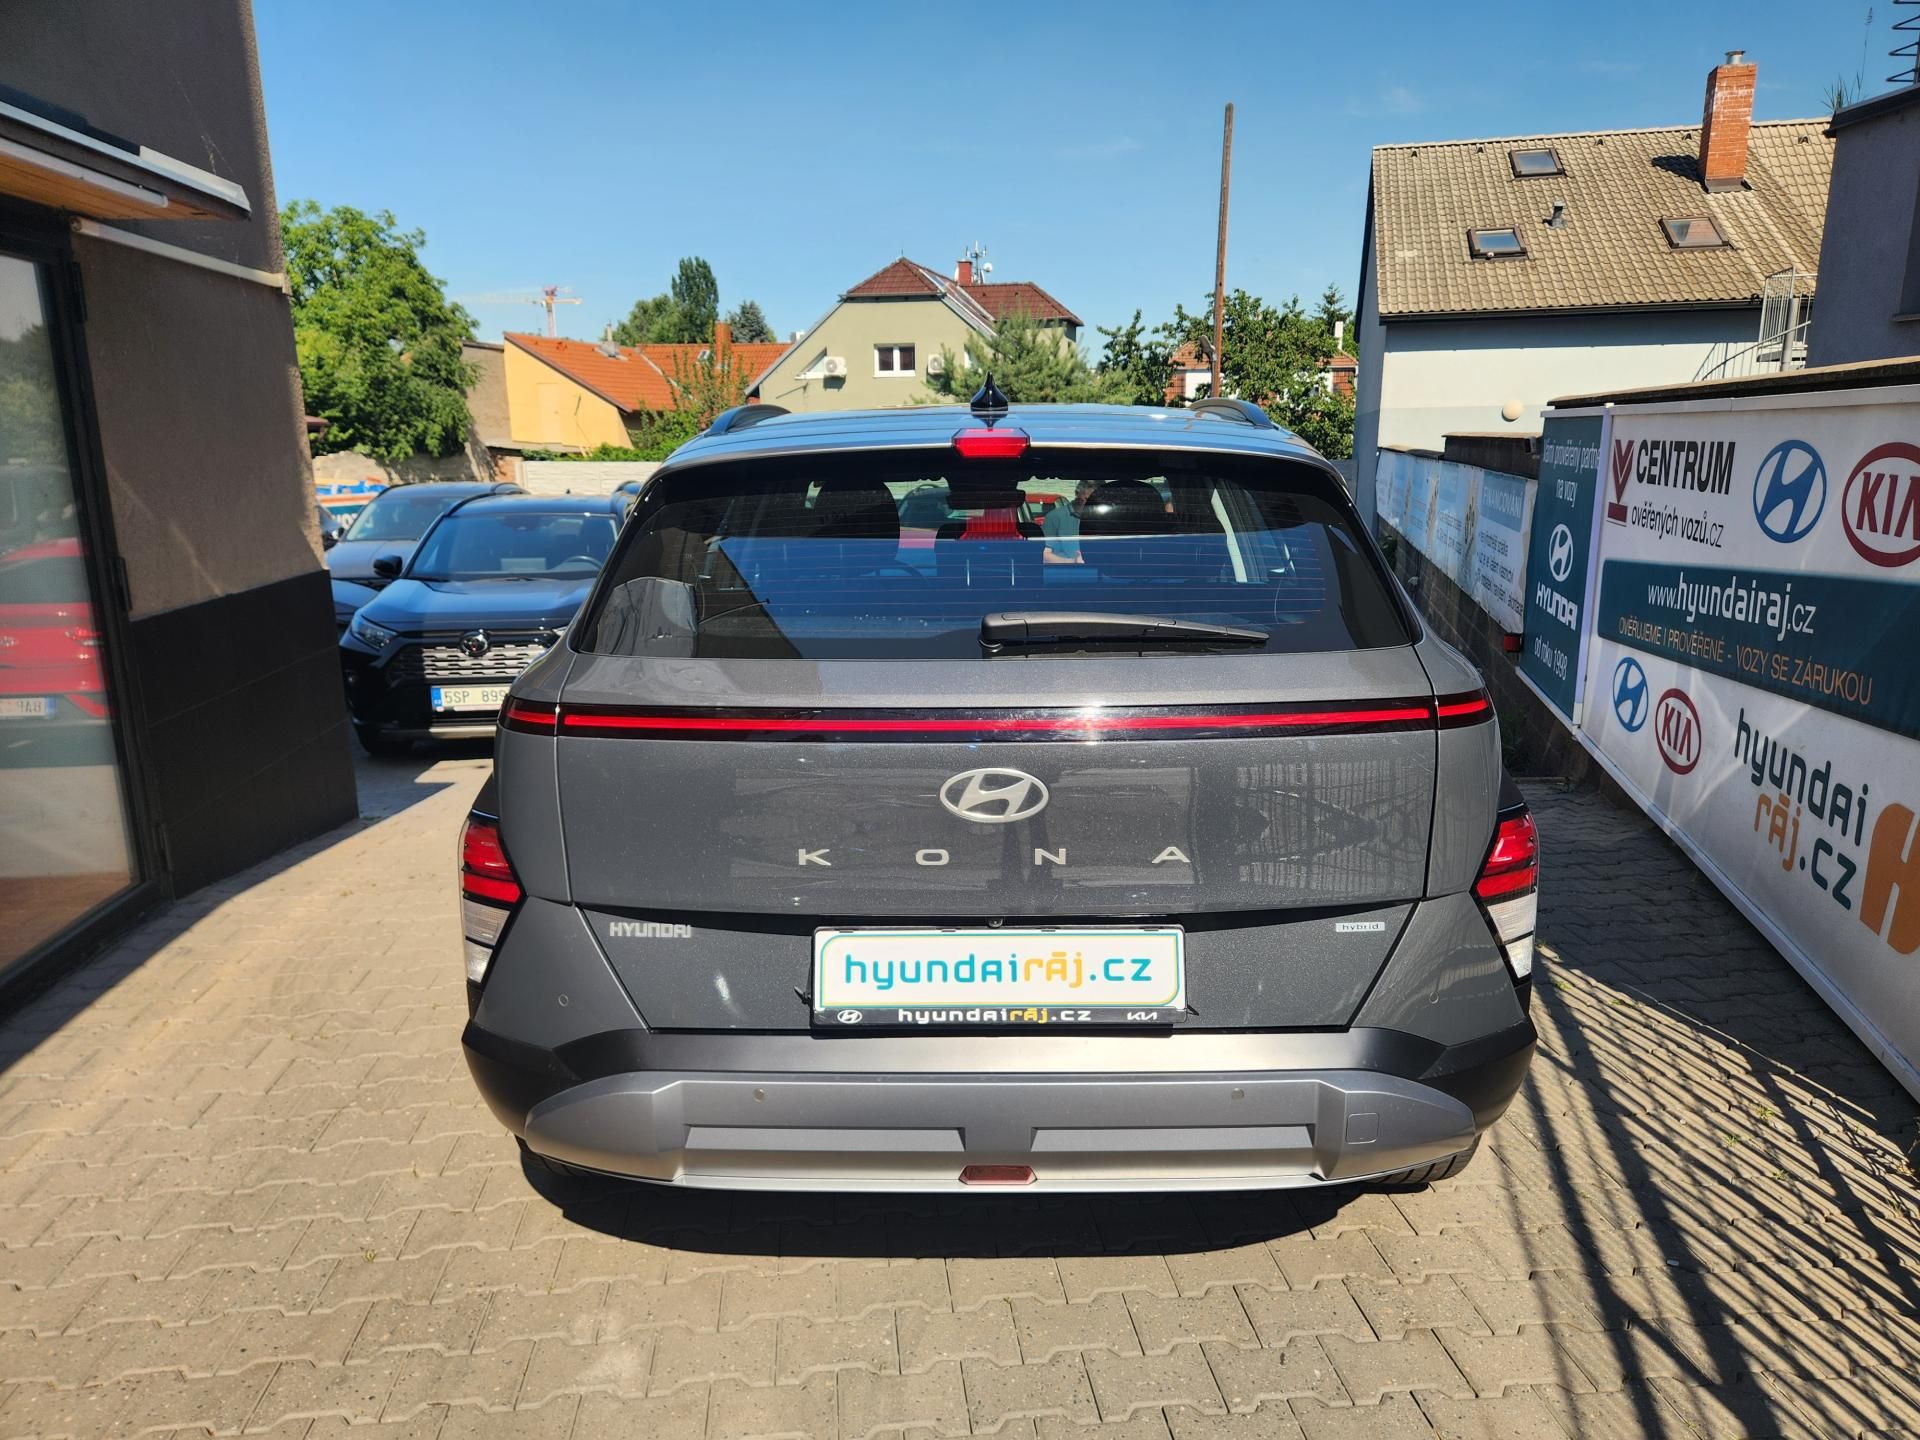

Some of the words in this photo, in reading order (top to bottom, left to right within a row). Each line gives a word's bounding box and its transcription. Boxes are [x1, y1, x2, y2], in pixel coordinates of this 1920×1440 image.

[1580, 442, 1600, 474] partne
[1636, 438, 1736, 496] CENTRUM
[1556, 479, 1564, 499] na
[1564, 480, 1578, 508] vozy
[1631, 501, 1679, 540] ověřených
[1681, 510, 1724, 548] vozů.cz
[1536, 581, 1578, 631] HYUNDAI
[1648, 571, 1817, 641] www.hyundairaj.cz
[1534, 635, 1542, 658] od
[1541, 641, 1553, 668] roku
[1553, 647, 1568, 680] 1998
[1668, 629, 1725, 663] PROVĚŘENÉ
[1736, 645, 1769, 675] VOZY
[1770, 654, 1790, 682] SE
[1792, 655, 1873, 705] ZÁRUKOU
[444, 690, 470, 704] 5SP
[1661, 703, 1691, 762] KIA
[1734, 707, 1869, 847] hyundai
[798, 846, 1191, 866] KONA
[609, 922, 692, 938] HYUNDAI
[1342, 923, 1379, 931] hybrid
